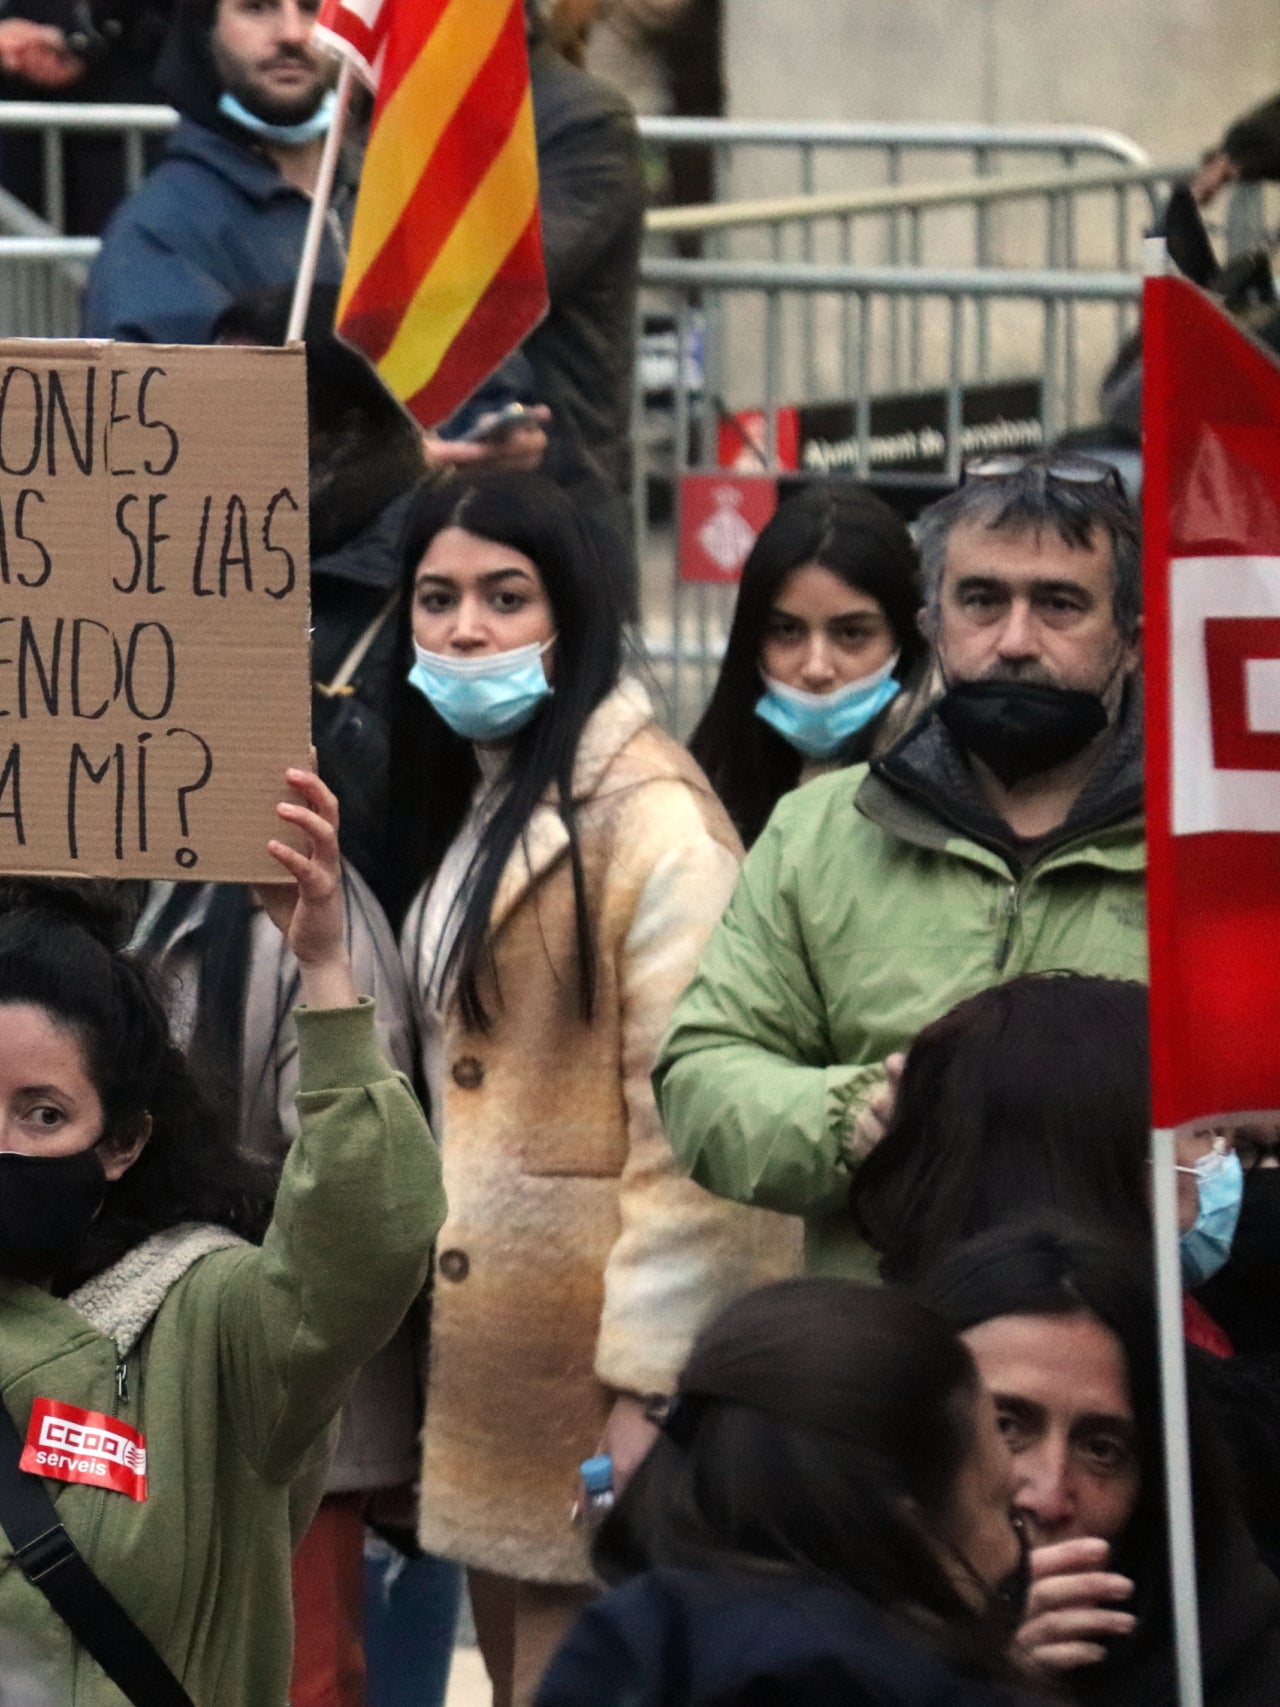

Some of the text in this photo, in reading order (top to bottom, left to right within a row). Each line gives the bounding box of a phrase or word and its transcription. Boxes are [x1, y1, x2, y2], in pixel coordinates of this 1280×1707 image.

[113, 492, 170, 594] SE
[192, 487, 299, 599] LAS
[67, 726, 214, 868] MÍ?
[36, 1452, 107, 1475] serveis
[46, 1423, 118, 1455] CCOO
